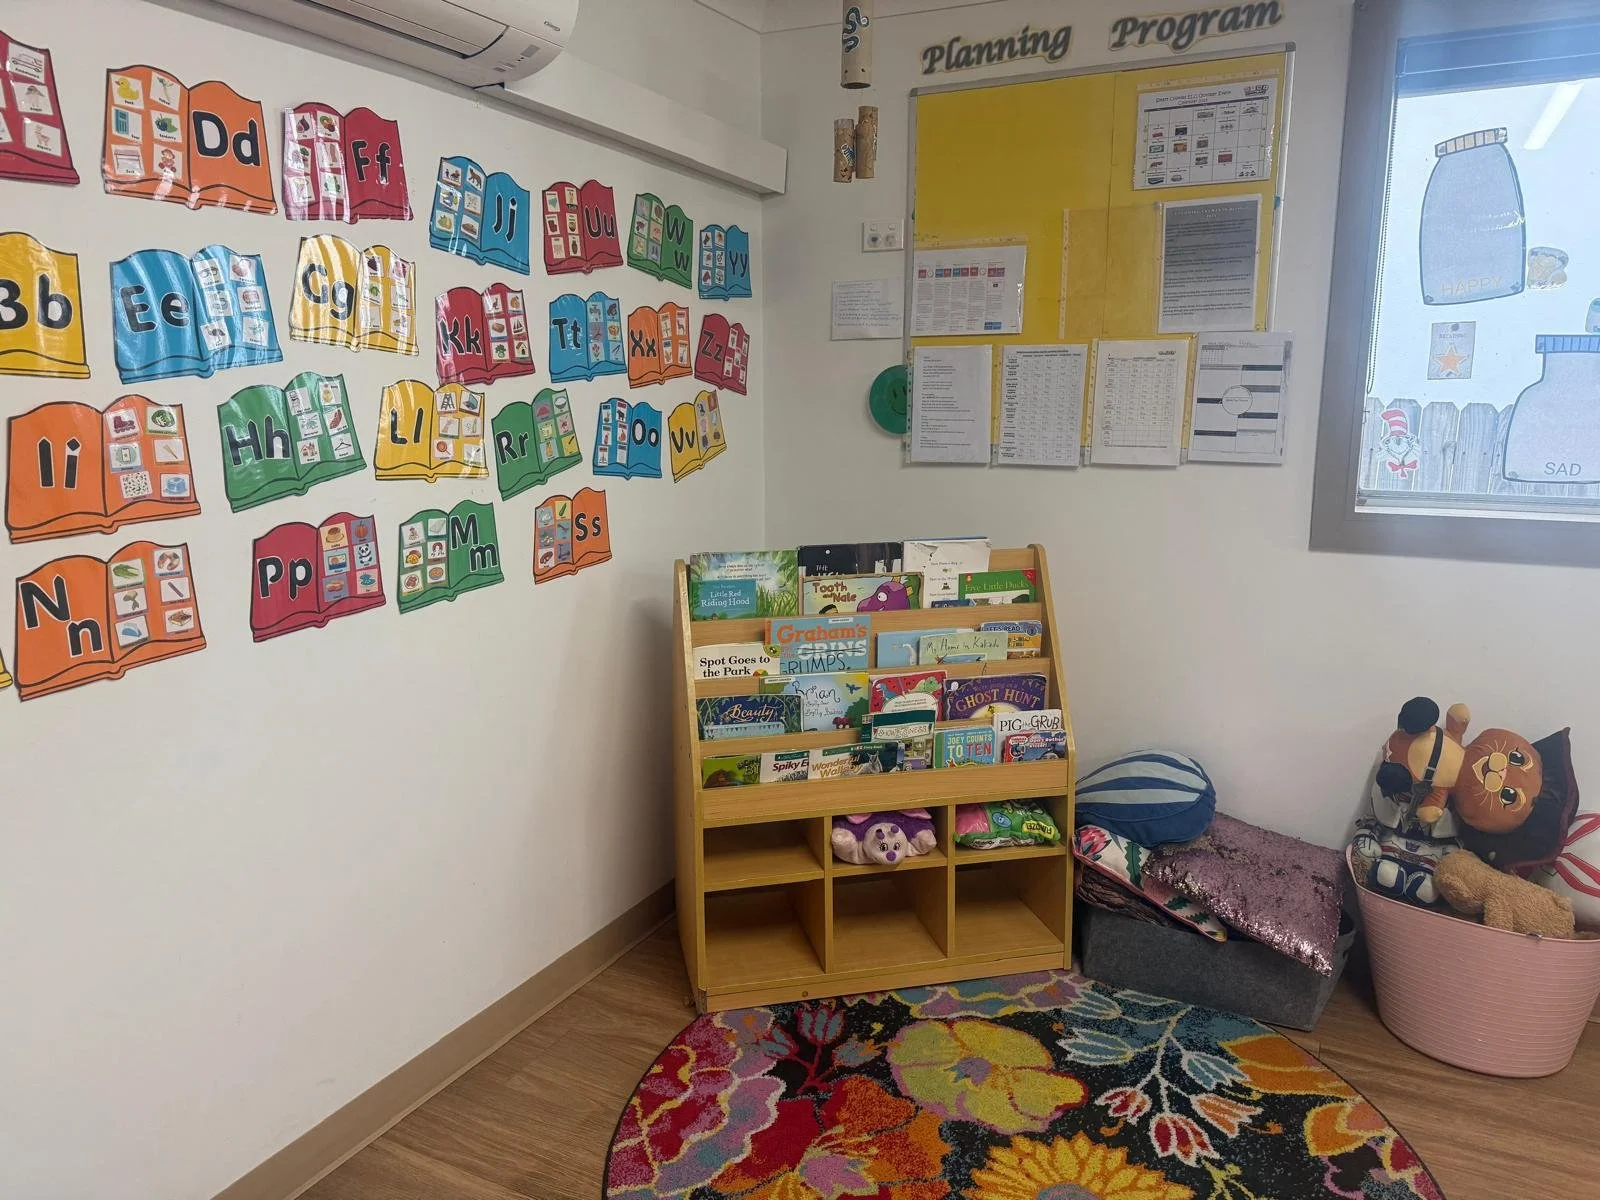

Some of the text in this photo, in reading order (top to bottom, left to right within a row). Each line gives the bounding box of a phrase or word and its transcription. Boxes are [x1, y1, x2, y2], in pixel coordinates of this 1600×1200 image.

[1111, 1, 1283, 50] Program
[922, 24, 1072, 73] Planning
[193, 111, 260, 166] Dd
[352, 141, 391, 183] Ff
[493, 192, 517, 242] Jj
[585, 207, 615, 238] Uu
[728, 250, 748, 277] Yy
[1440, 275, 1502, 297] HAPPY
[119, 285, 190, 332] Ee
[440, 315, 481, 355] Kk
[553, 318, 582, 349] Tt
[630, 330, 657, 357] Xx
[701, 330, 723, 362] Zz
[390, 408, 424, 445] Ll
[632, 418, 659, 447] Oo
[225, 416, 290, 466] Hh
[495, 430, 528, 465] Rr
[670, 427, 695, 454] Vv
[1544, 462, 1581, 476] SAD
[575, 512, 601, 542] Ss
[258, 557, 312, 600] Pp
[812, 581, 847, 594] Tooth
[965, 582, 1029, 592] Five Little Ducks
[701, 599, 727, 608] Riding
[710, 590, 741, 599] Little Red
[777, 623, 867, 644] Graham's
[798, 639, 867, 660] GRINS
[700, 657, 726, 669] Spot
[728, 656, 756, 665] Goes
[703, 666, 750, 677] the Park
[792, 681, 841, 703] Brian
[955, 688, 999, 712] GHOST
[1003, 688, 1041, 709] HUNT
[729, 703, 776, 723] Beauty
[1000, 718, 1022, 732] PIG
[1030, 715, 1060, 730] GRUB
[947, 742, 992, 759] TO TEN
[948, 734, 993, 745] JOEY COUNTS
[773, 760, 799, 772] Spiky
[811, 756, 861, 771] Wonderful
[819, 765, 863, 778] Wallaby
